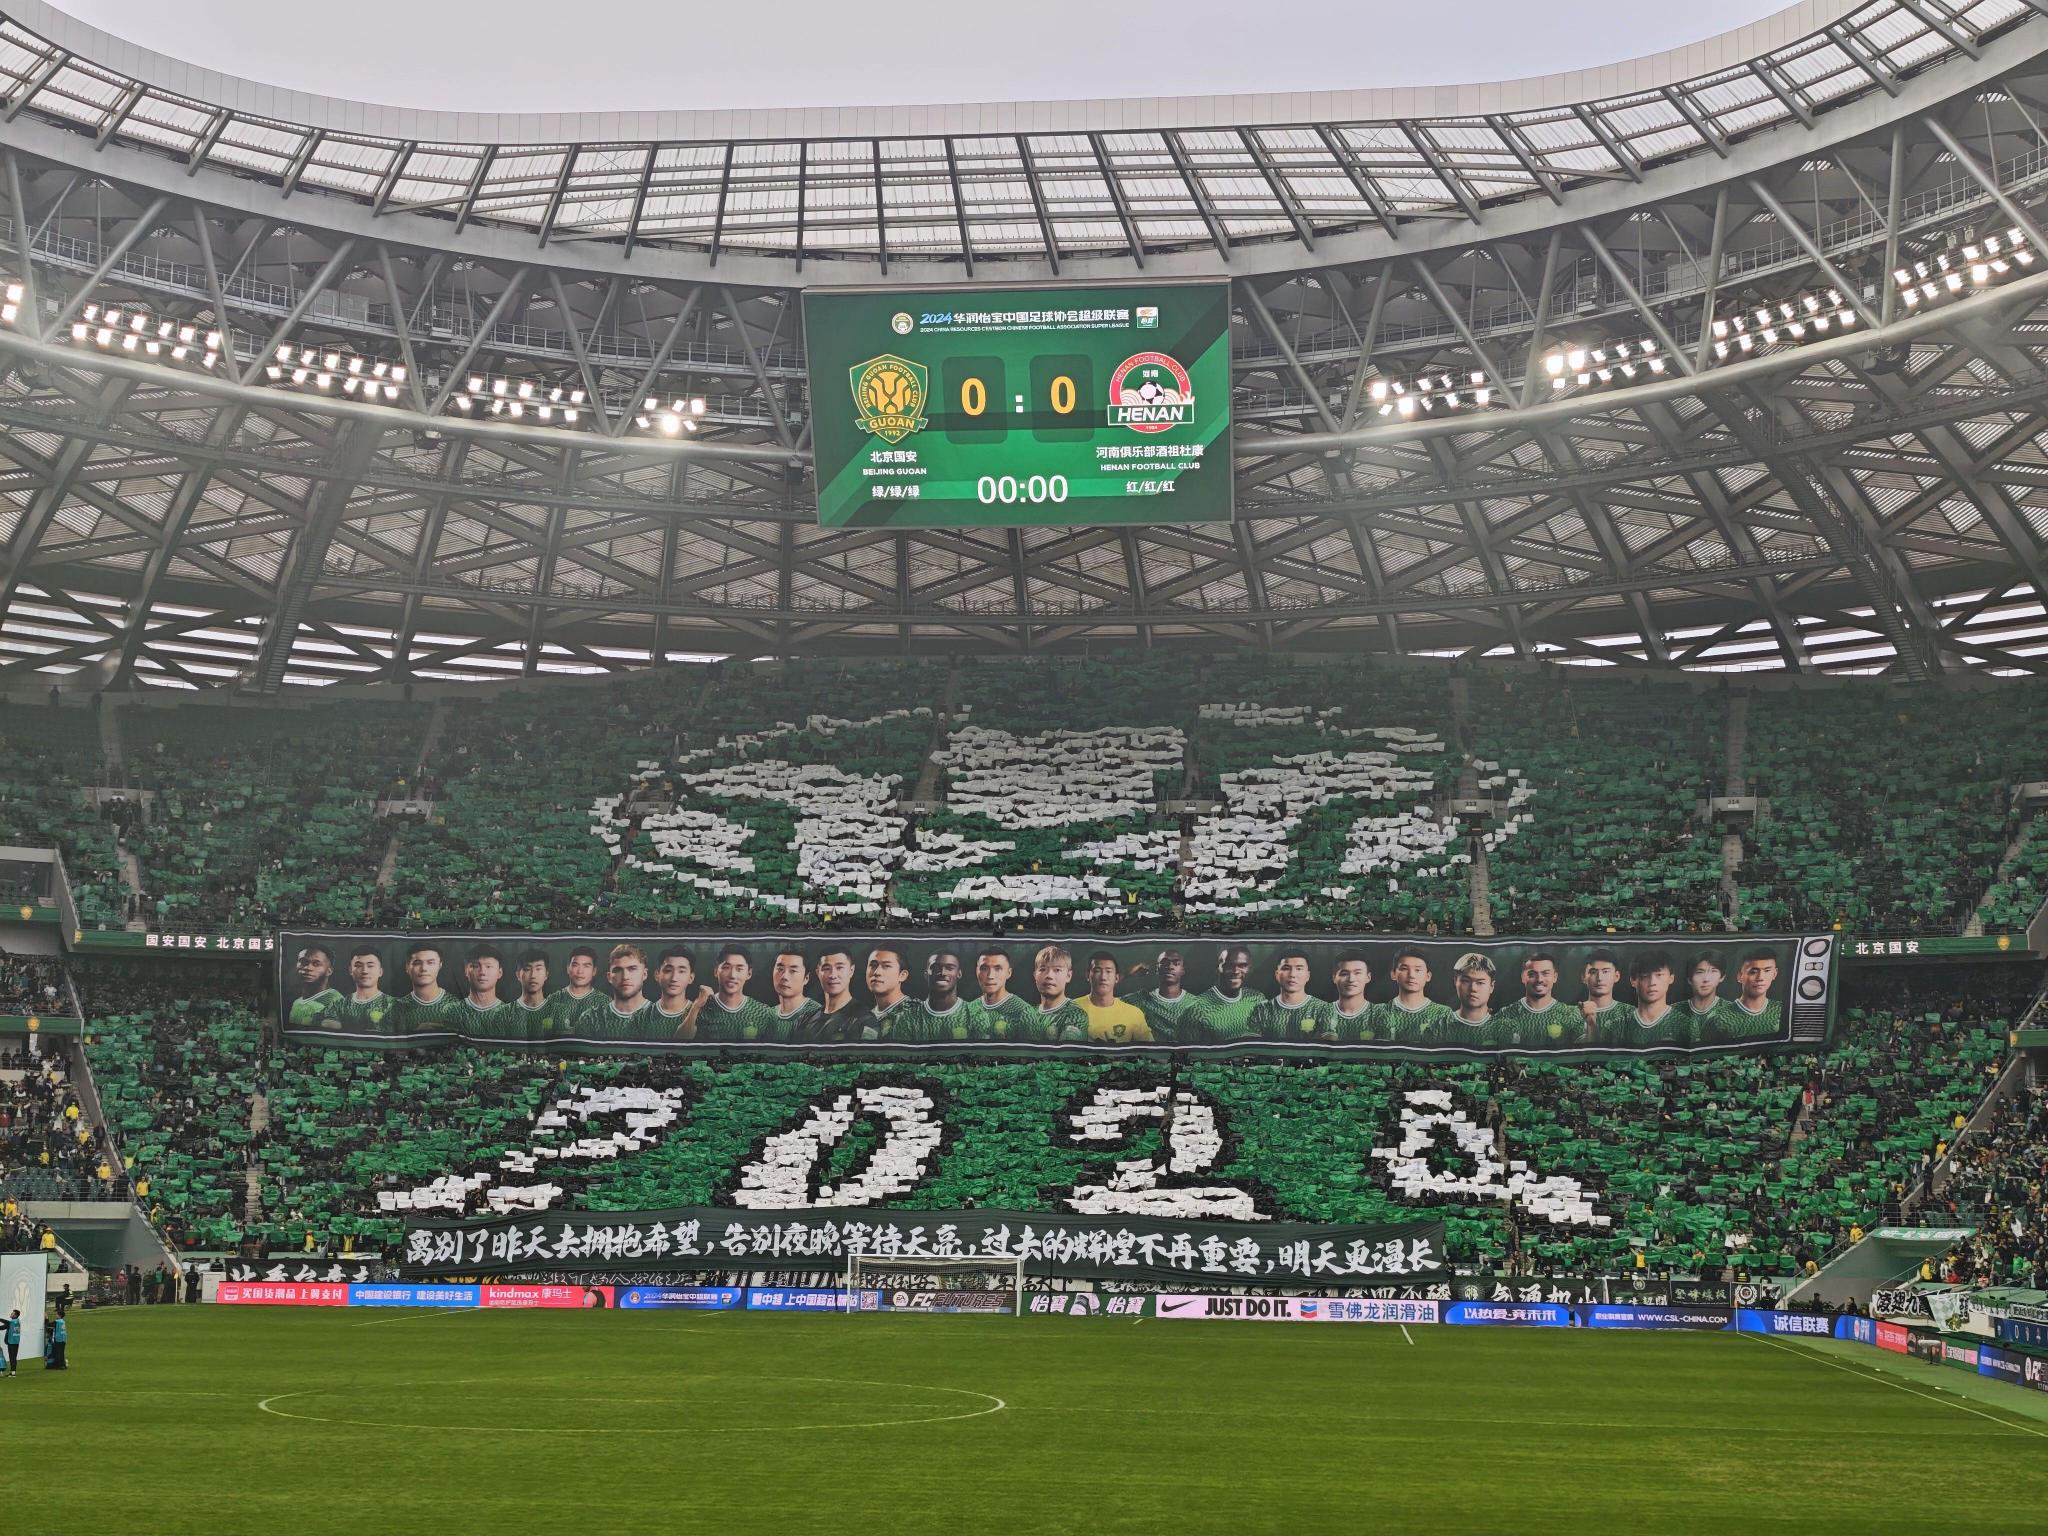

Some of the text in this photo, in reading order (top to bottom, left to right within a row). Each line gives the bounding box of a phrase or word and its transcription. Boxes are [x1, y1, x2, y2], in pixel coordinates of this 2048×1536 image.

[1115, 354, 1187, 383] HENAN FOOTBALL CLUB
[866, 364, 888, 379] GUOAN
[889, 364, 919, 389] FOOTBALL
[961, 377, 986, 417] 0
[1050, 375, 1076, 415] 0
[1117, 406, 1184, 422] HENAN
[869, 418, 915, 429] GUOAN
[870, 451, 917, 463] 北京国安
[1096, 444, 1204, 459] 河南俱乐部酒祖杜康
[863, 467, 927, 476] BEIJING GUOAN
[1100, 462, 1200, 471] HENAN FOOTBALL CLUB
[872, 485, 920, 498] 绿/绿/绿
[977, 476, 1069, 505] 00:00
[1126, 480, 1175, 493] 红/红/红
[146, 934, 207, 948] 国安国安
[1855, 940, 1920, 954] 北京国安
[355, 1290, 473, 1301] 中国建设银行 建设美好生活
[489, 1287, 572, 1299] kindmax 康玛士
[910, 1292, 936, 1307] FC
[1204, 1298, 1292, 1318] JUST DO IT.
[1328, 1301, 1435, 1322] 雪佛龙润滑油
[1637, 1313, 1728, 1324] WWW.CSL-CHINA.COM
[1773, 1314, 1830, 1334] 诚信联赛
